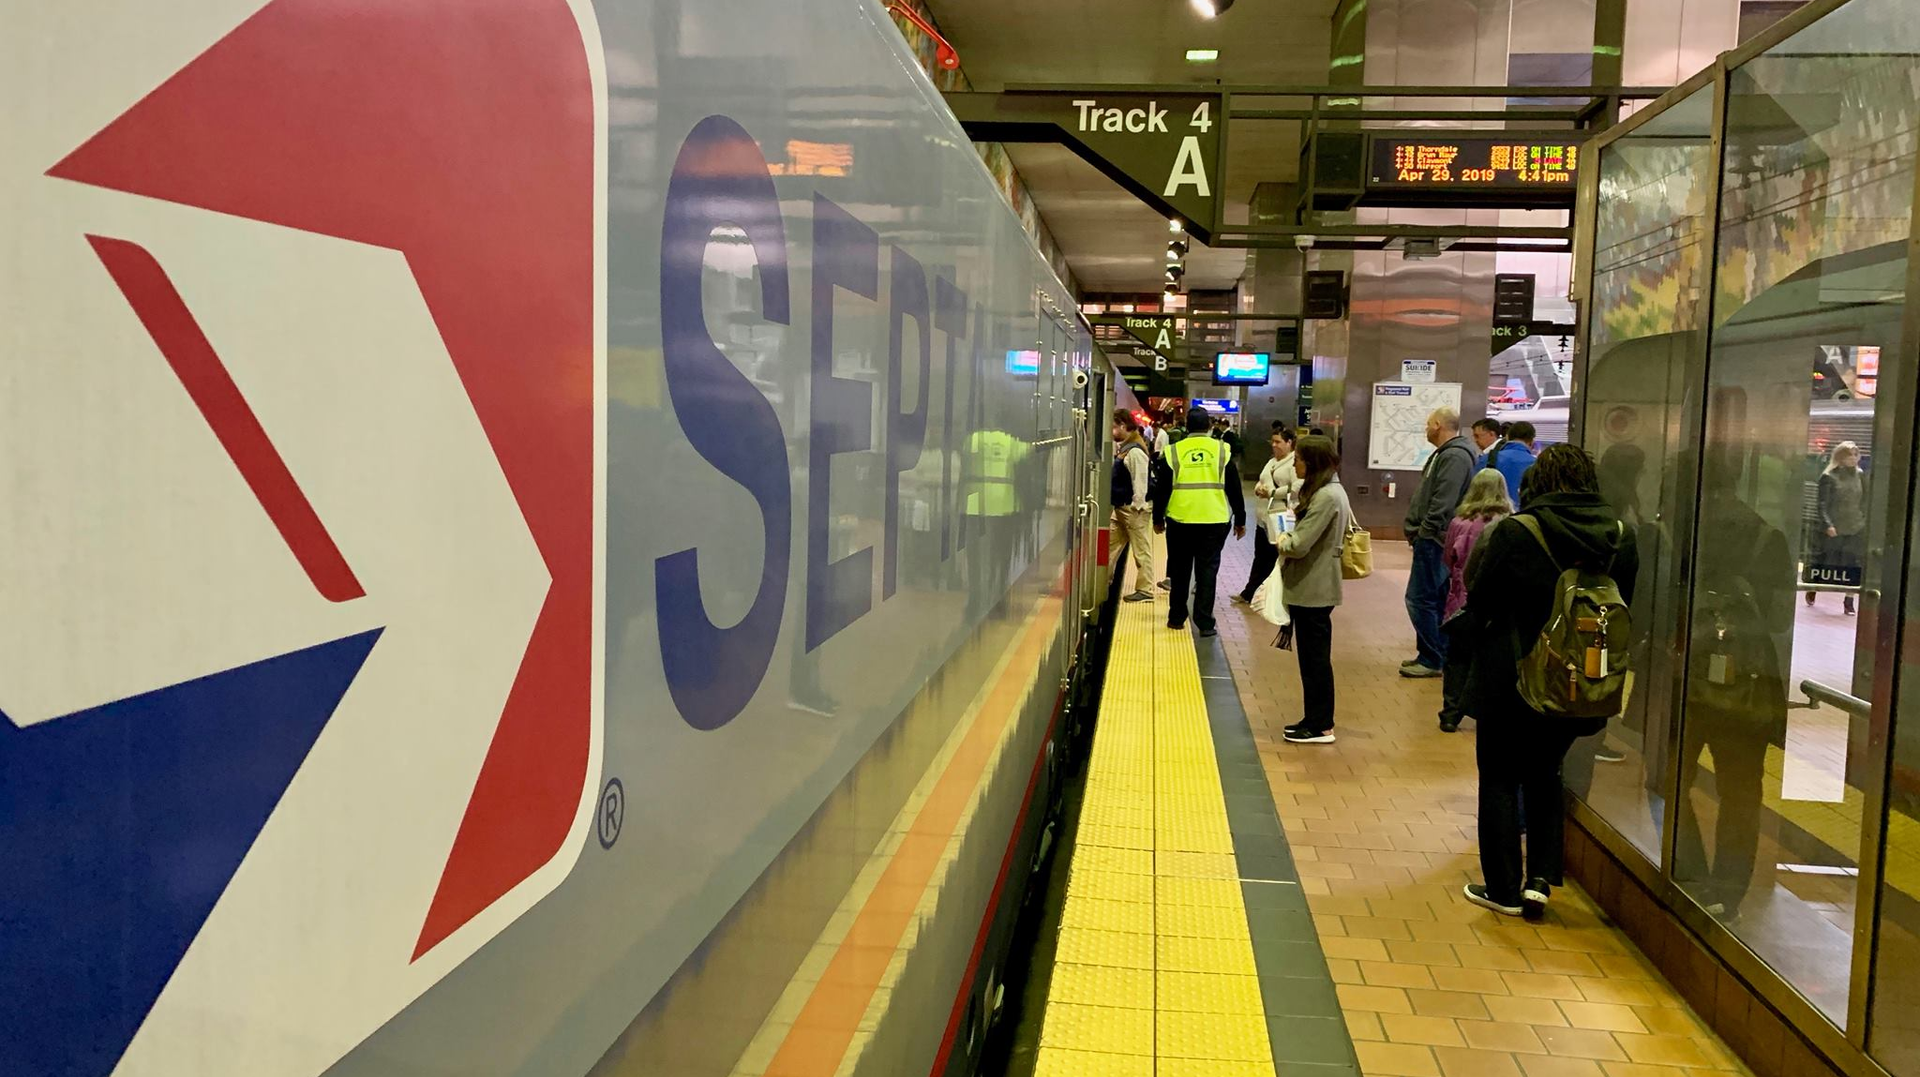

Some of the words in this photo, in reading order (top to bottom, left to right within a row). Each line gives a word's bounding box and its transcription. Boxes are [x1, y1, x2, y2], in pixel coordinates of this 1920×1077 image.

[1072, 100, 1169, 133] Track
[1189, 101, 1213, 133] 4
[1163, 136, 1211, 196] A
[1398, 169, 1425, 182] Apr
[1461, 169, 1496, 182] 2019
[1518, 169, 1570, 182] 4:41pm
[1125, 317, 1157, 328] Track
[1162, 318, 1172, 328] 4
[1518, 325, 1528, 336] 3
[1154, 328, 1171, 349] A
[1155, 356, 1168, 371] B
[655, 115, 986, 731] SEPTA
[1811, 569, 1851, 582] PULL
